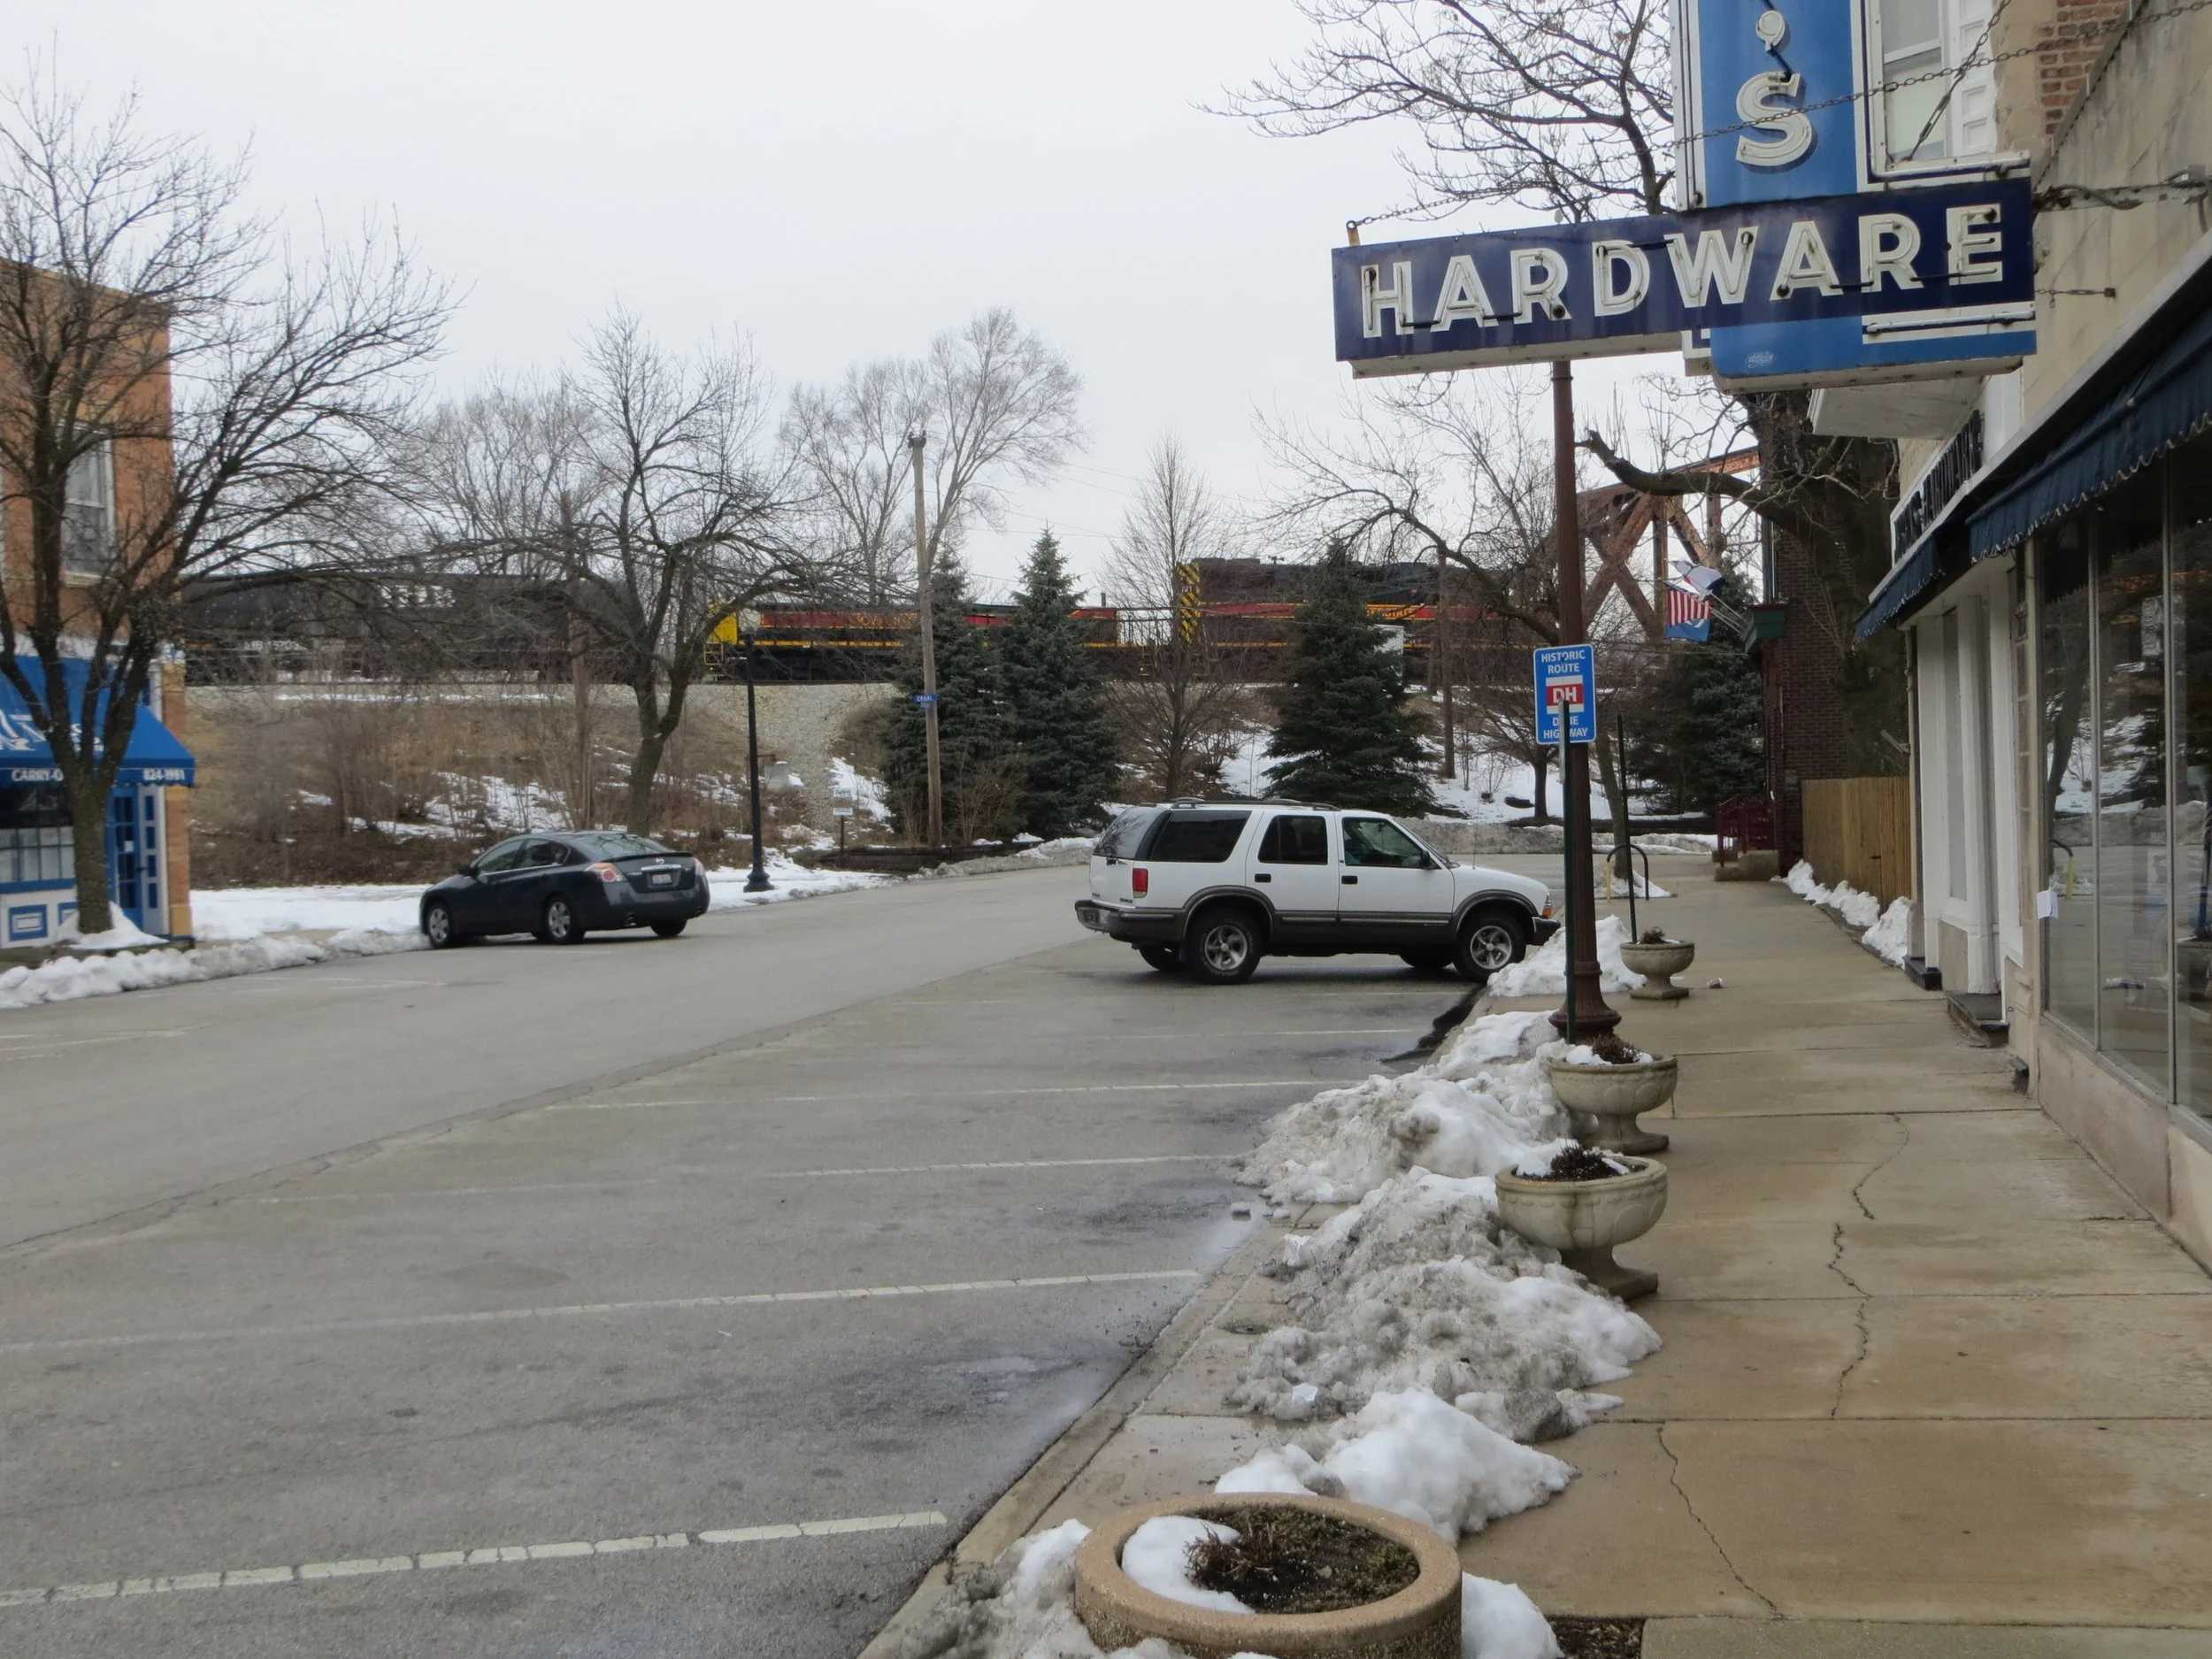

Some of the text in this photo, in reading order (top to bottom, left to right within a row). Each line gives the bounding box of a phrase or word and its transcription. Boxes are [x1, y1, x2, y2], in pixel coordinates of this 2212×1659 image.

[1362, 204, 2003, 338] HARDWARE
[1541, 649, 1586, 663] HISTORIC
[1548, 663, 1580, 674] ROUTE
[1552, 687, 1577, 703] DH
[1552, 716, 1578, 726] DIE
[1543, 727, 1589, 740] HIGWAY
[12, 768, 65, 782] CARRY-O
